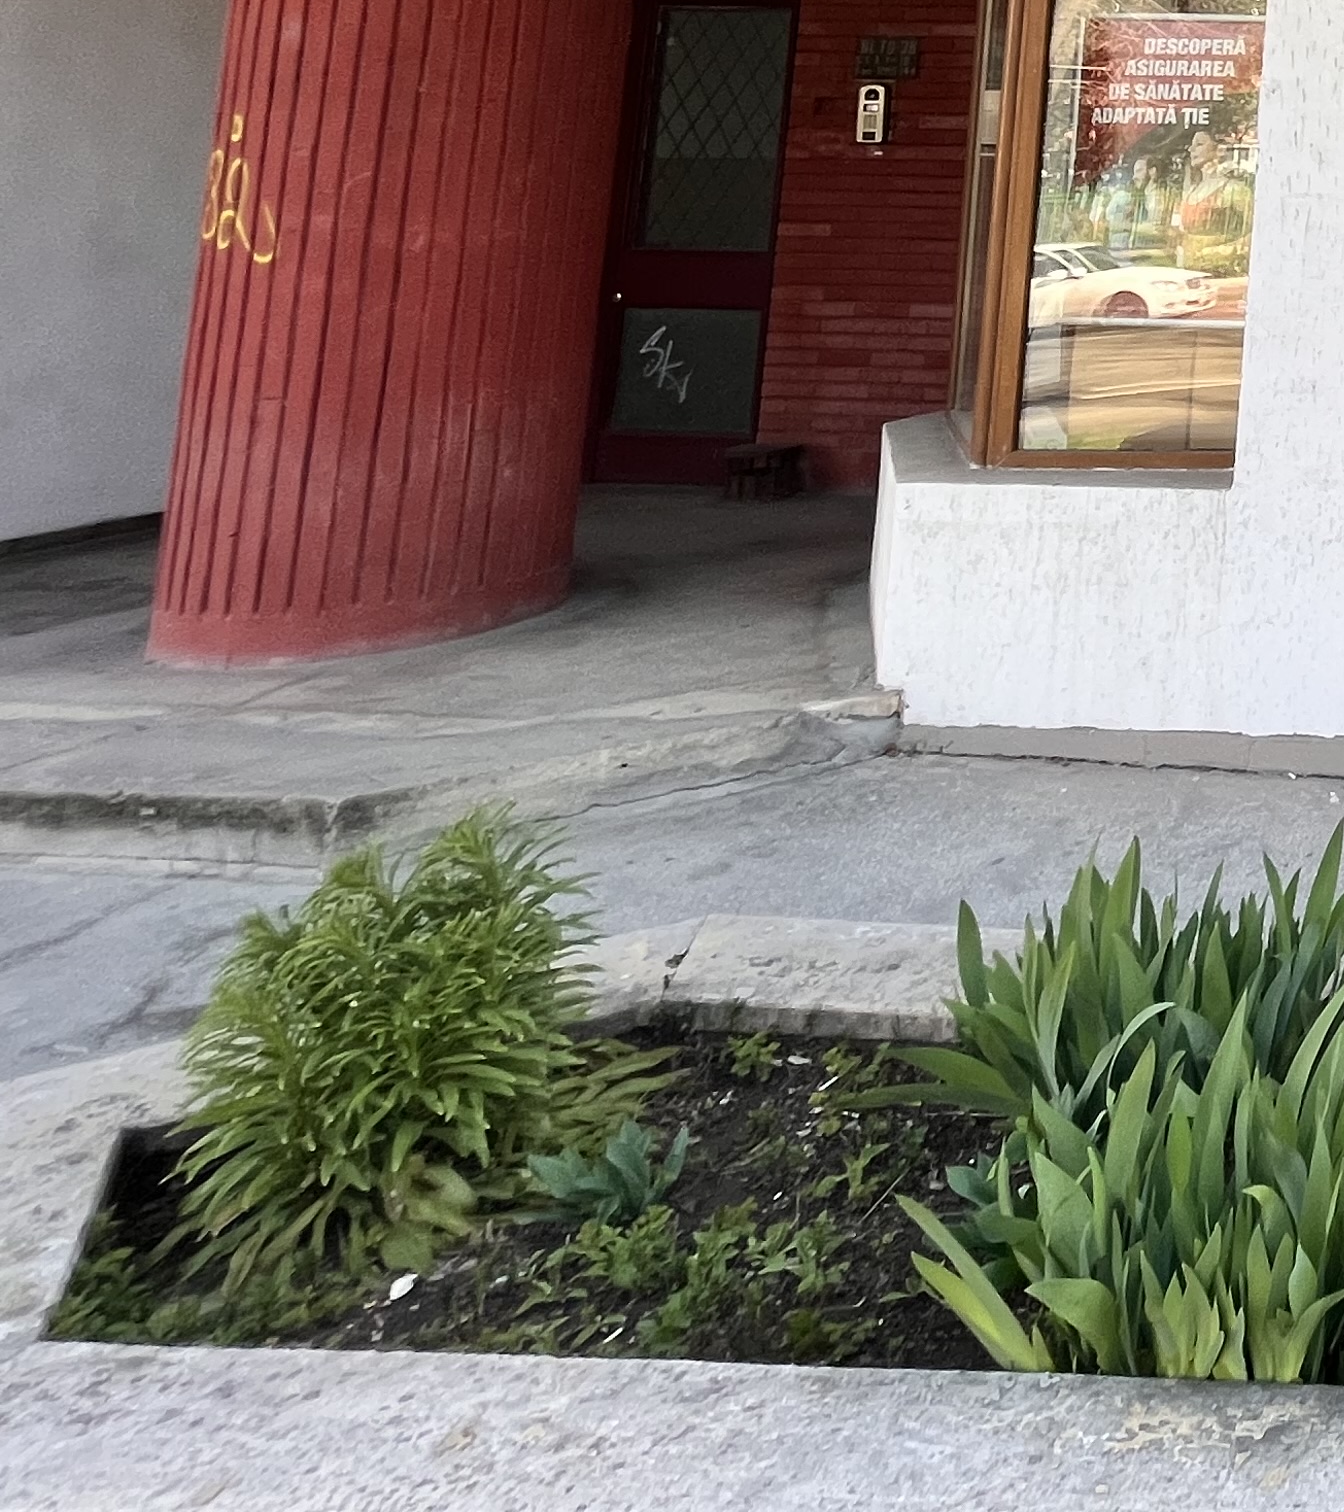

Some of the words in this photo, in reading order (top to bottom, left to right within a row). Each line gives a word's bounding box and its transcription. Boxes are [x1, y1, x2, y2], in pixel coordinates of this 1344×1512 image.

[1124, 60, 1235, 78] ASIGURAREA
[1108, 84, 1130, 101] DE
[1134, 80, 1224, 101] SĂNĂTATE
[1091, 104, 1177, 125] ADAPTATĂ
